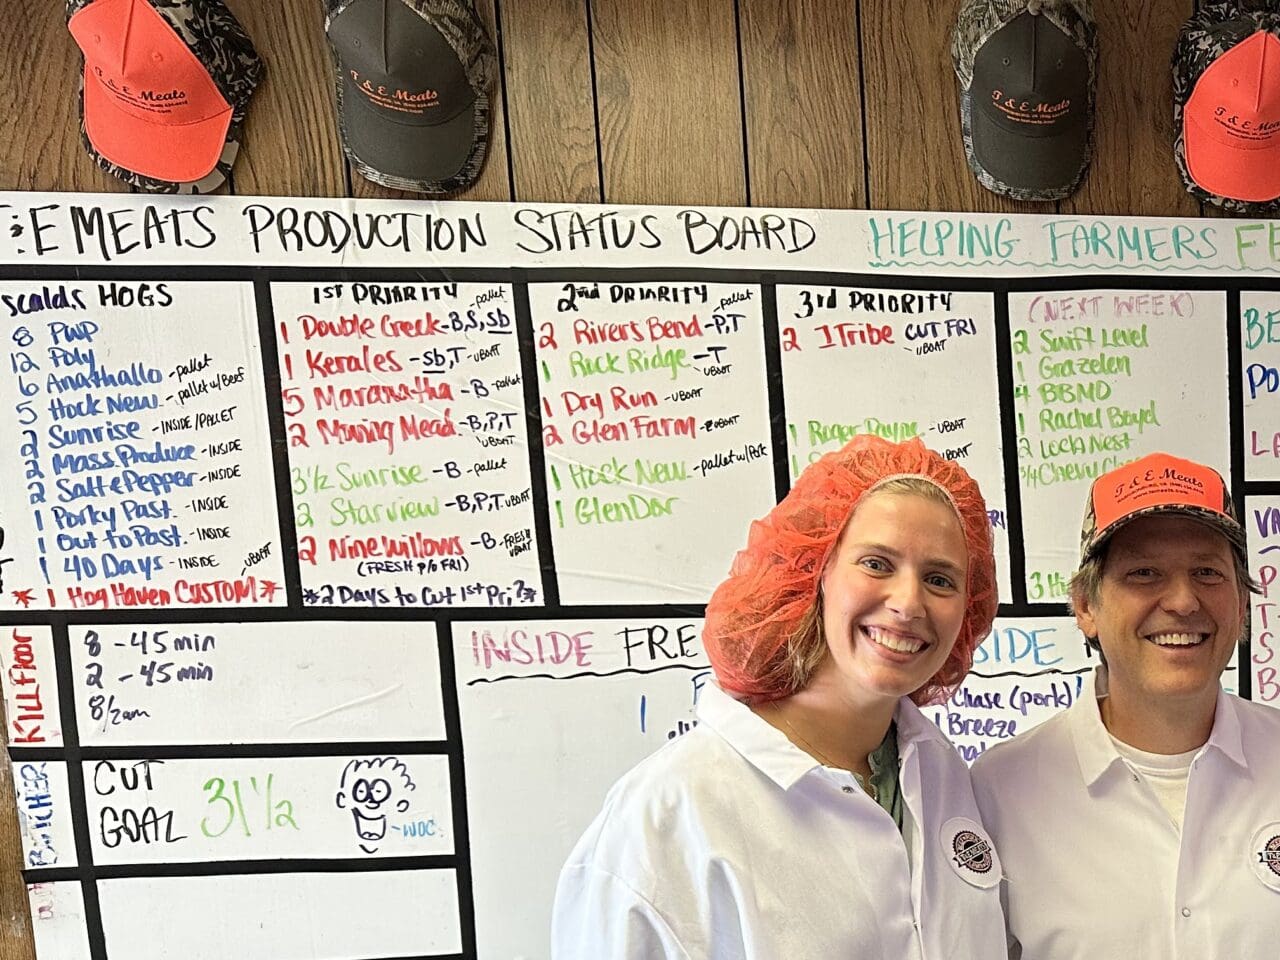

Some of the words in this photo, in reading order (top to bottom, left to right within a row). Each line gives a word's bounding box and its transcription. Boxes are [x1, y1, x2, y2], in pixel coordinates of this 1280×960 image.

[138, 89, 186, 102] Meats
[377, 85, 388, 96] E
[391, 89, 438, 102] Meats
[1031, 99, 1070, 113] Meats
[69, 205, 217, 262] MEATS
[242, 204, 490, 254] PRODUCTION
[515, 207, 662, 255] STATUS
[678, 206, 816, 255] BOARD
[868, 217, 1019, 262] HELPING
[1045, 219, 1217, 263] FARMERS
[98, 282, 174, 308] HOGS
[793, 288, 838, 319] 3rd
[848, 290, 953, 314] PRIORITY
[12, 325, 35, 348] 8
[297, 312, 376, 341] Double
[380, 311, 445, 339] Creek
[538, 321, 558, 350] 2
[646, 313, 705, 343] Bend
[781, 326, 803, 352] 2
[904, 321, 943, 342] CUT
[944, 317, 978, 339] FRI
[1013, 329, 1033, 355] 2
[1038, 326, 1096, 355] Swift
[1101, 323, 1150, 349] Level
[10, 351, 41, 375] 12
[47, 346, 97, 378] Poly
[626, 344, 692, 381] Ridge
[18, 375, 40, 398] 6
[16, 400, 39, 426] 5
[281, 387, 306, 417] 5
[560, 390, 605, 420] Dry
[609, 385, 659, 412] Run
[1039, 405, 1104, 433] Rachel
[1105, 399, 1162, 435] Boyd
[20, 429, 39, 459] 2
[47, 420, 145, 450] Sunrise
[290, 422, 311, 448] 2
[541, 424, 565, 448] 2
[571, 416, 630, 446] Glen
[629, 415, 698, 441] Farm
[1017, 436, 1034, 459] 2
[25, 459, 46, 480] 2
[335, 461, 430, 492] Sunrise
[1158, 467, 1204, 489] Meats
[27, 481, 47, 505] 2
[50, 503, 117, 531] Porky
[296, 502, 315, 528] 2
[56, 532, 99, 552] Out
[102, 532, 133, 550] to
[298, 535, 318, 566] 2
[63, 554, 98, 581] 40
[101, 552, 165, 581] Days
[1258, 564, 1278, 599] P
[66, 586, 111, 610] Hog
[111, 581, 171, 607] Haven
[174, 575, 260, 605] CUSTOM
[336, 584, 391, 608] Days
[394, 585, 418, 604] to
[84, 630, 102, 657] 8
[174, 632, 217, 652] min
[471, 629, 596, 670] INSIDE
[615, 622, 700, 667] FRE
[175, 661, 214, 683] min
[13, 683, 46, 744] KILL
[948, 712, 1019, 739] Breeze
[94, 758, 165, 796] CUT
[99, 806, 188, 849] GOAL
